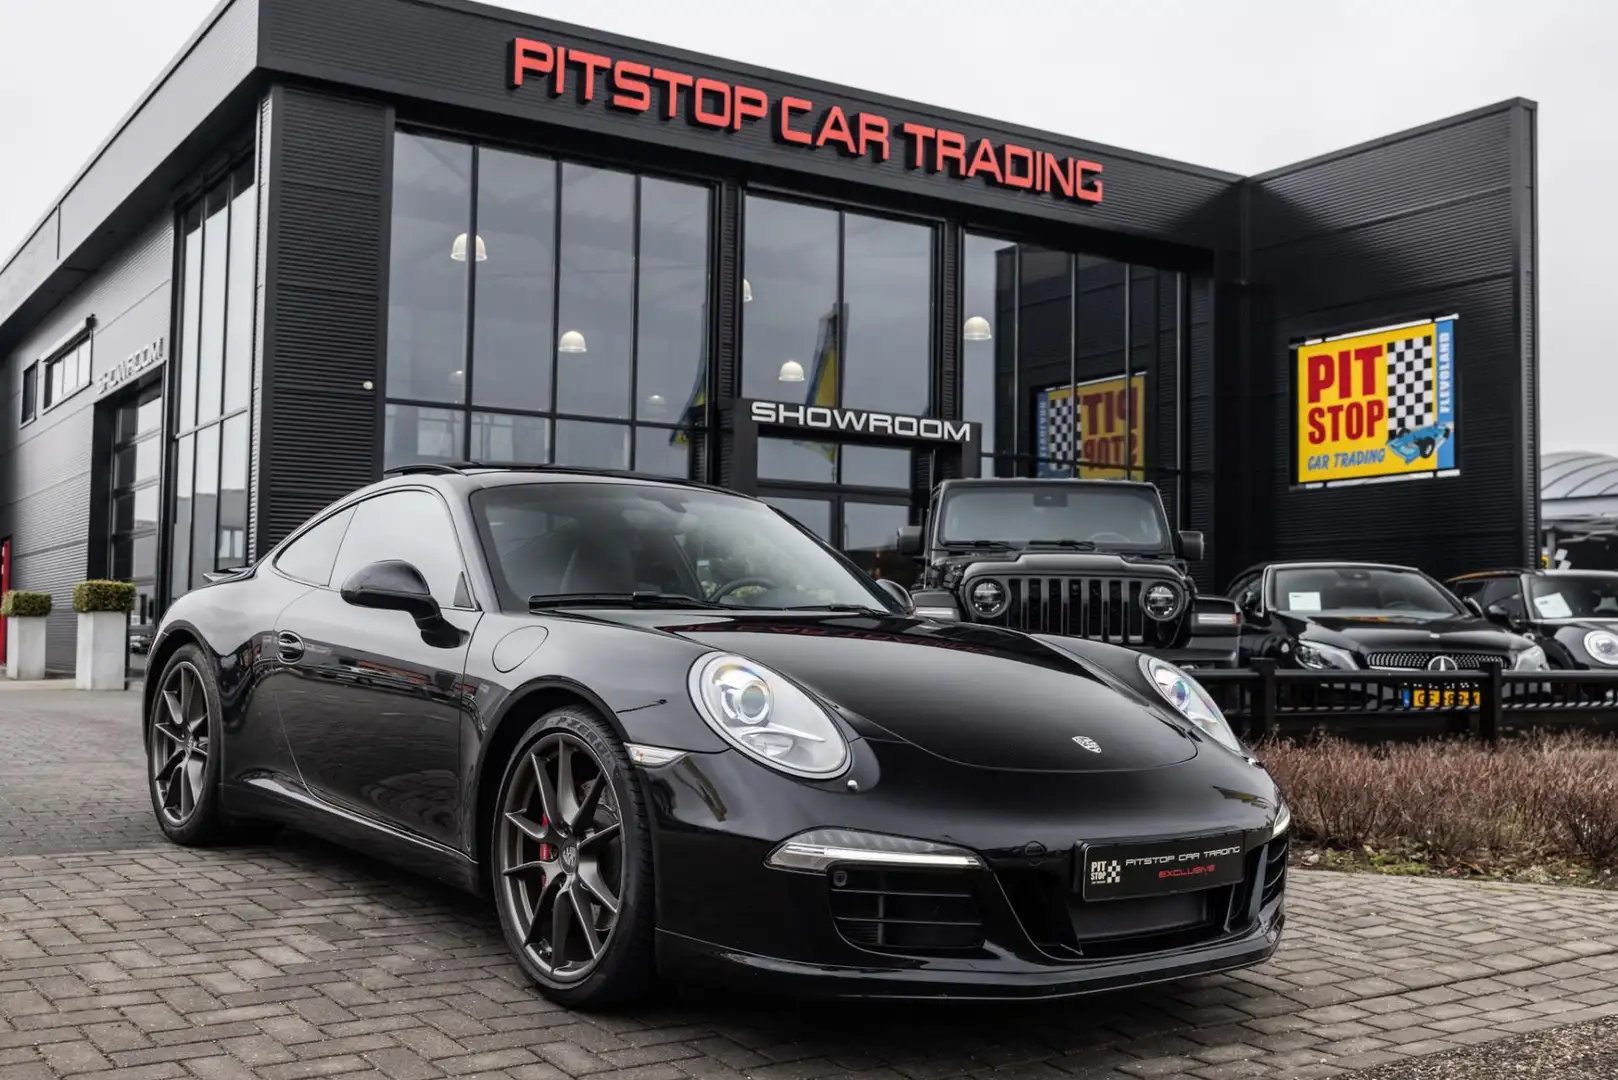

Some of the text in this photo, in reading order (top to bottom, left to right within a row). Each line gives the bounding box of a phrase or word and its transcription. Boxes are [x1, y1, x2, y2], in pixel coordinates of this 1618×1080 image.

[512, 37, 1103, 203] PITSTOP CAR TRADING
[1307, 344, 1383, 404] PIT
[751, 401, 971, 442] SHOWROOM
[1307, 399, 1385, 445] STOP
[1307, 448, 1386, 471] CAR TRADING
[1091, 861, 1107, 872] PIT
[1125, 846, 1241, 867] PITSTOP CAR TRADING
[1090, 871, 1107, 881] STOP
[1158, 864, 1216, 878] EXCLUSIVE
